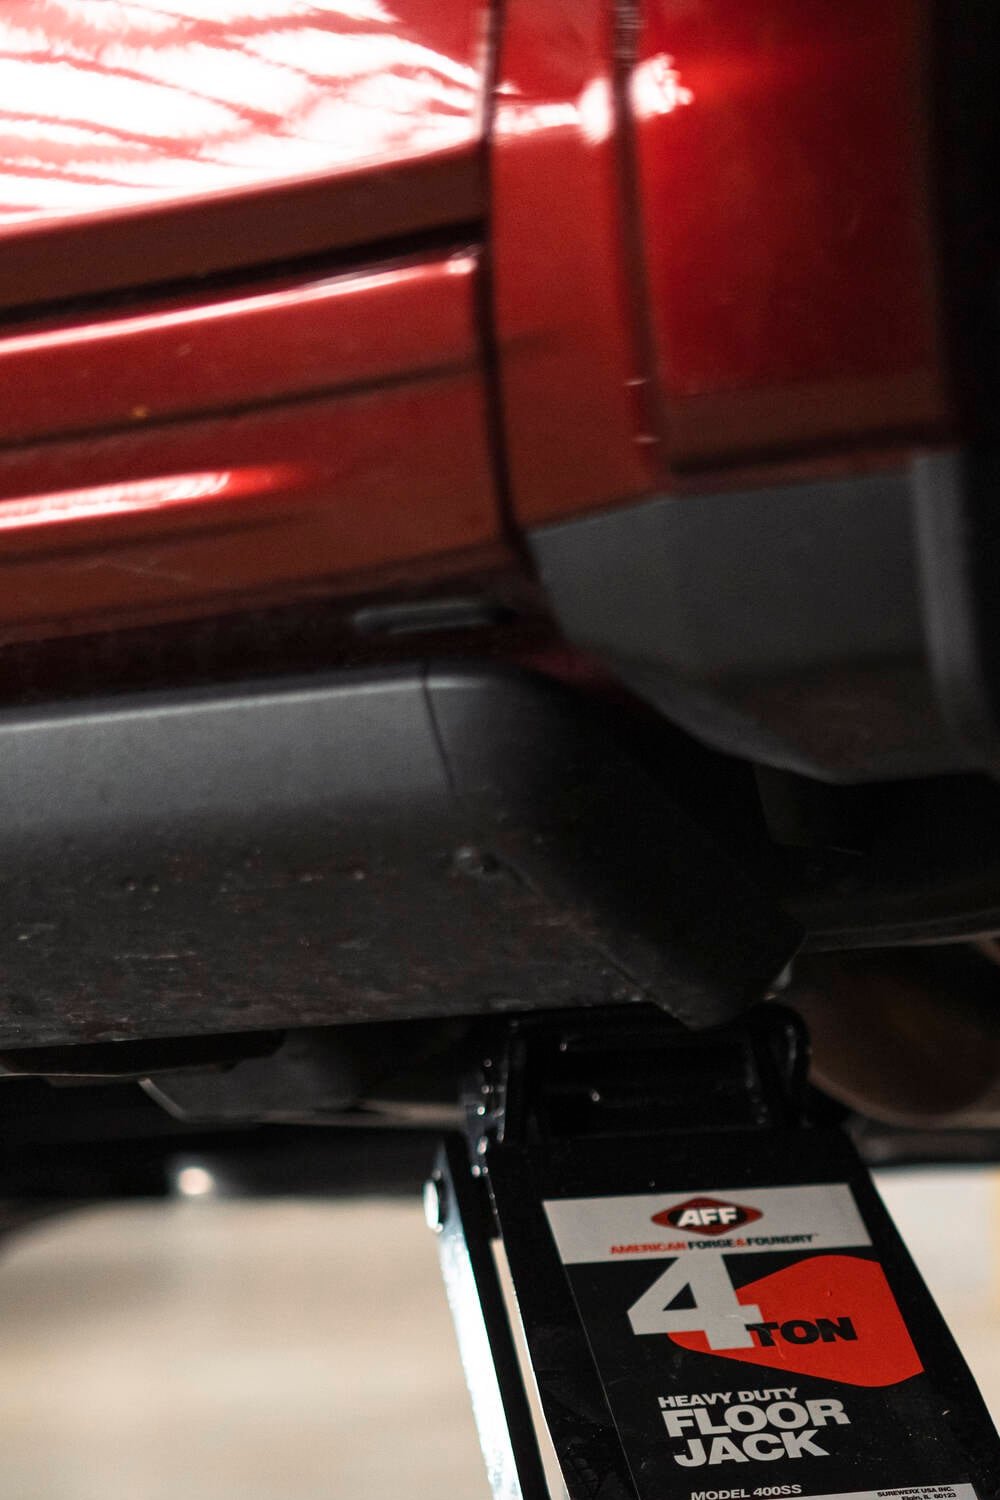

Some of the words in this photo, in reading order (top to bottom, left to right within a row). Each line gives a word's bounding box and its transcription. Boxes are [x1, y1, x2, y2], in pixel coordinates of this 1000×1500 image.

[677, 1207, 737, 1227] AFF
[610, 1242, 686, 1255] AMERICAN
[627, 1250, 764, 1350] 4
[743, 1317, 858, 1347] TON
[657, 1391, 732, 1409] HEAVY
[738, 1387, 798, 1403] DUTY
[660, 1398, 852, 1438] FLOOR
[673, 1429, 830, 1468] JACK
[753, 1484, 802, 1497] 400SS
[877, 1488, 920, 1498] SUREWERX
